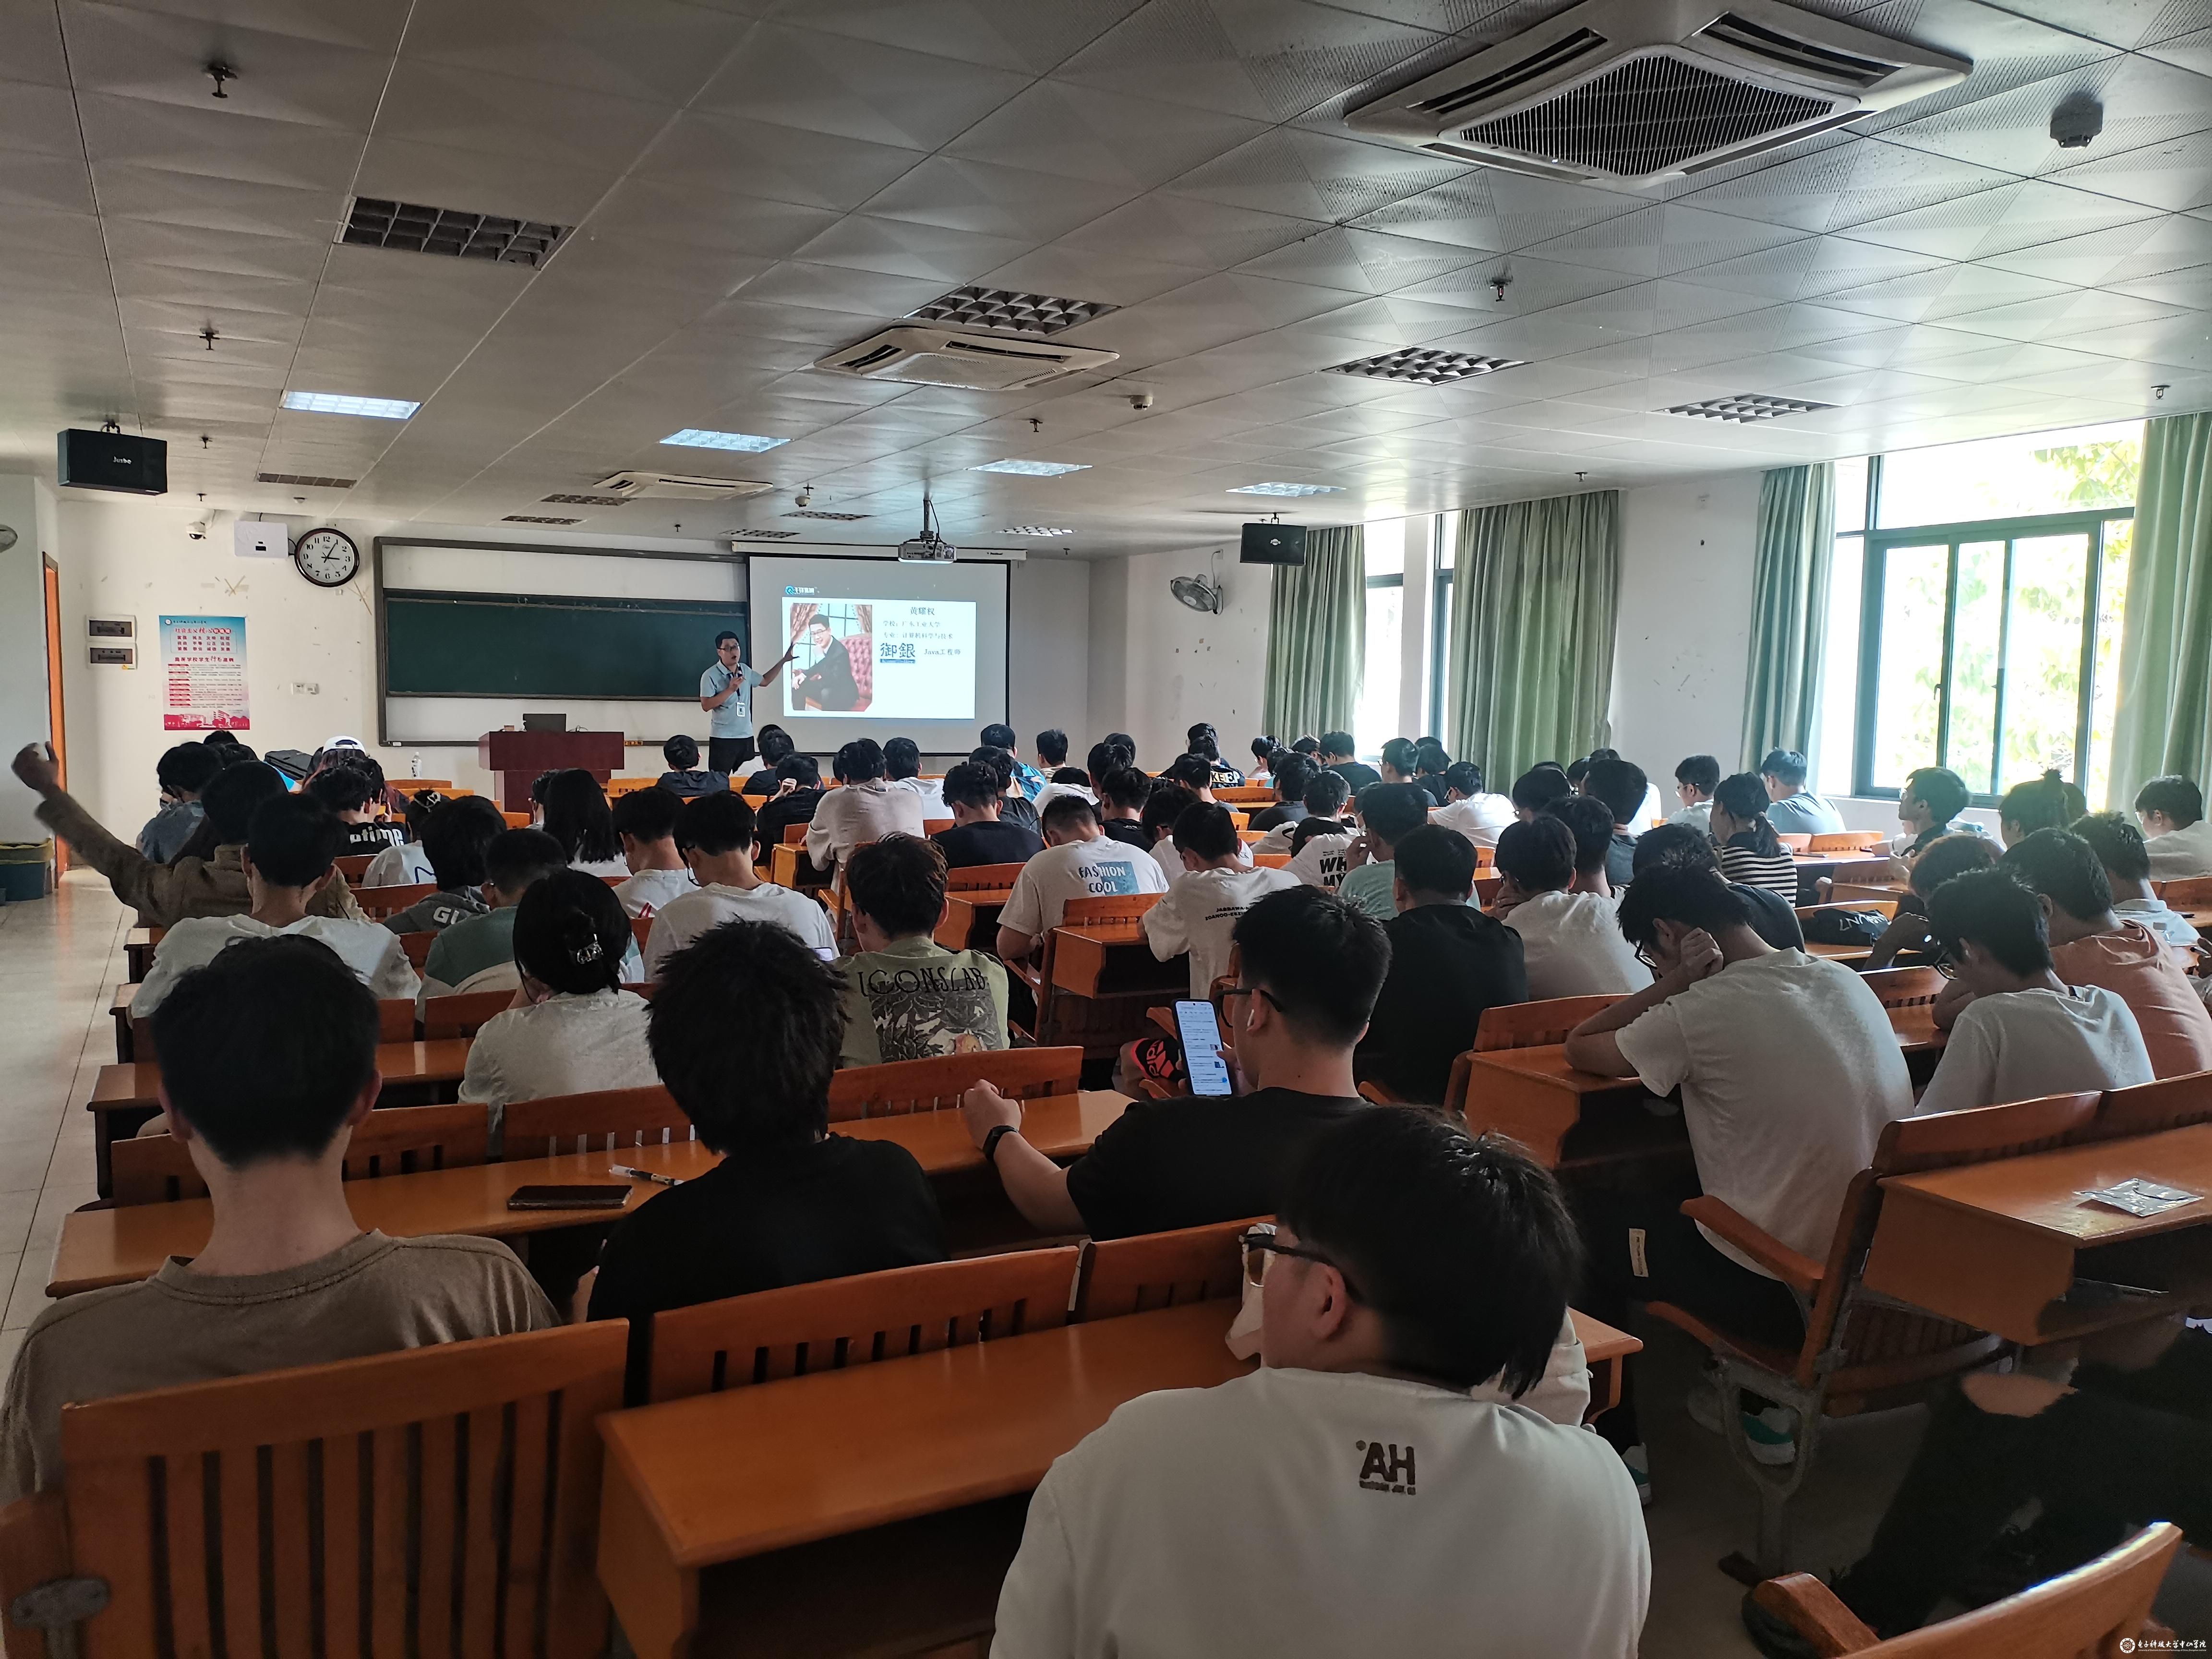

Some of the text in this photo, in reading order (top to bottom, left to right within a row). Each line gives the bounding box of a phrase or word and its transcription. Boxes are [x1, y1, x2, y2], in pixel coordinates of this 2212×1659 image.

[1210, 770, 1240, 784] KEEP
[1078, 866, 1126, 878] FASHION
[1088, 881, 1118, 893] COOL
